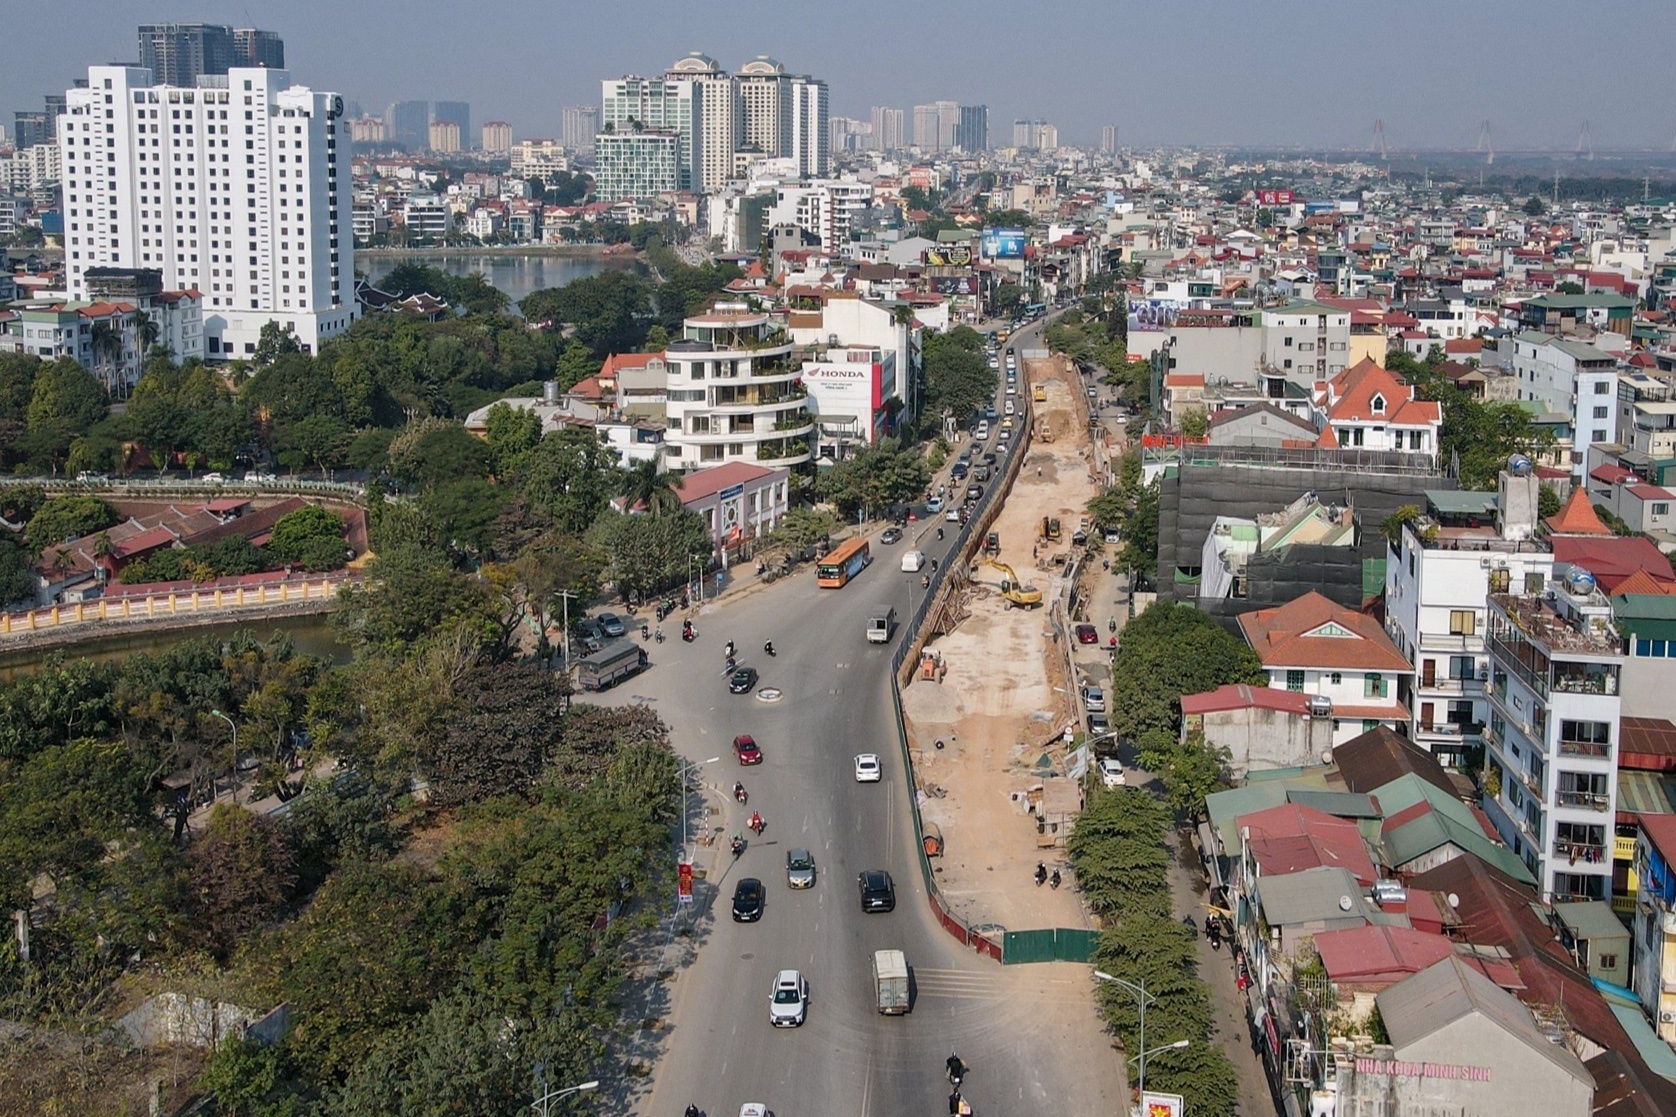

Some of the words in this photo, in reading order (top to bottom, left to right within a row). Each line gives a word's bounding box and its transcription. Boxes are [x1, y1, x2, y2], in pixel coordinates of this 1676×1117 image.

[820, 370, 865, 378] HONDA
[1356, 1058, 1382, 1073] NHA
[1386, 1060, 1420, 1076] KHOA
[1424, 1064, 1457, 1079] MINH
[1460, 1066, 1491, 1082] SINH
